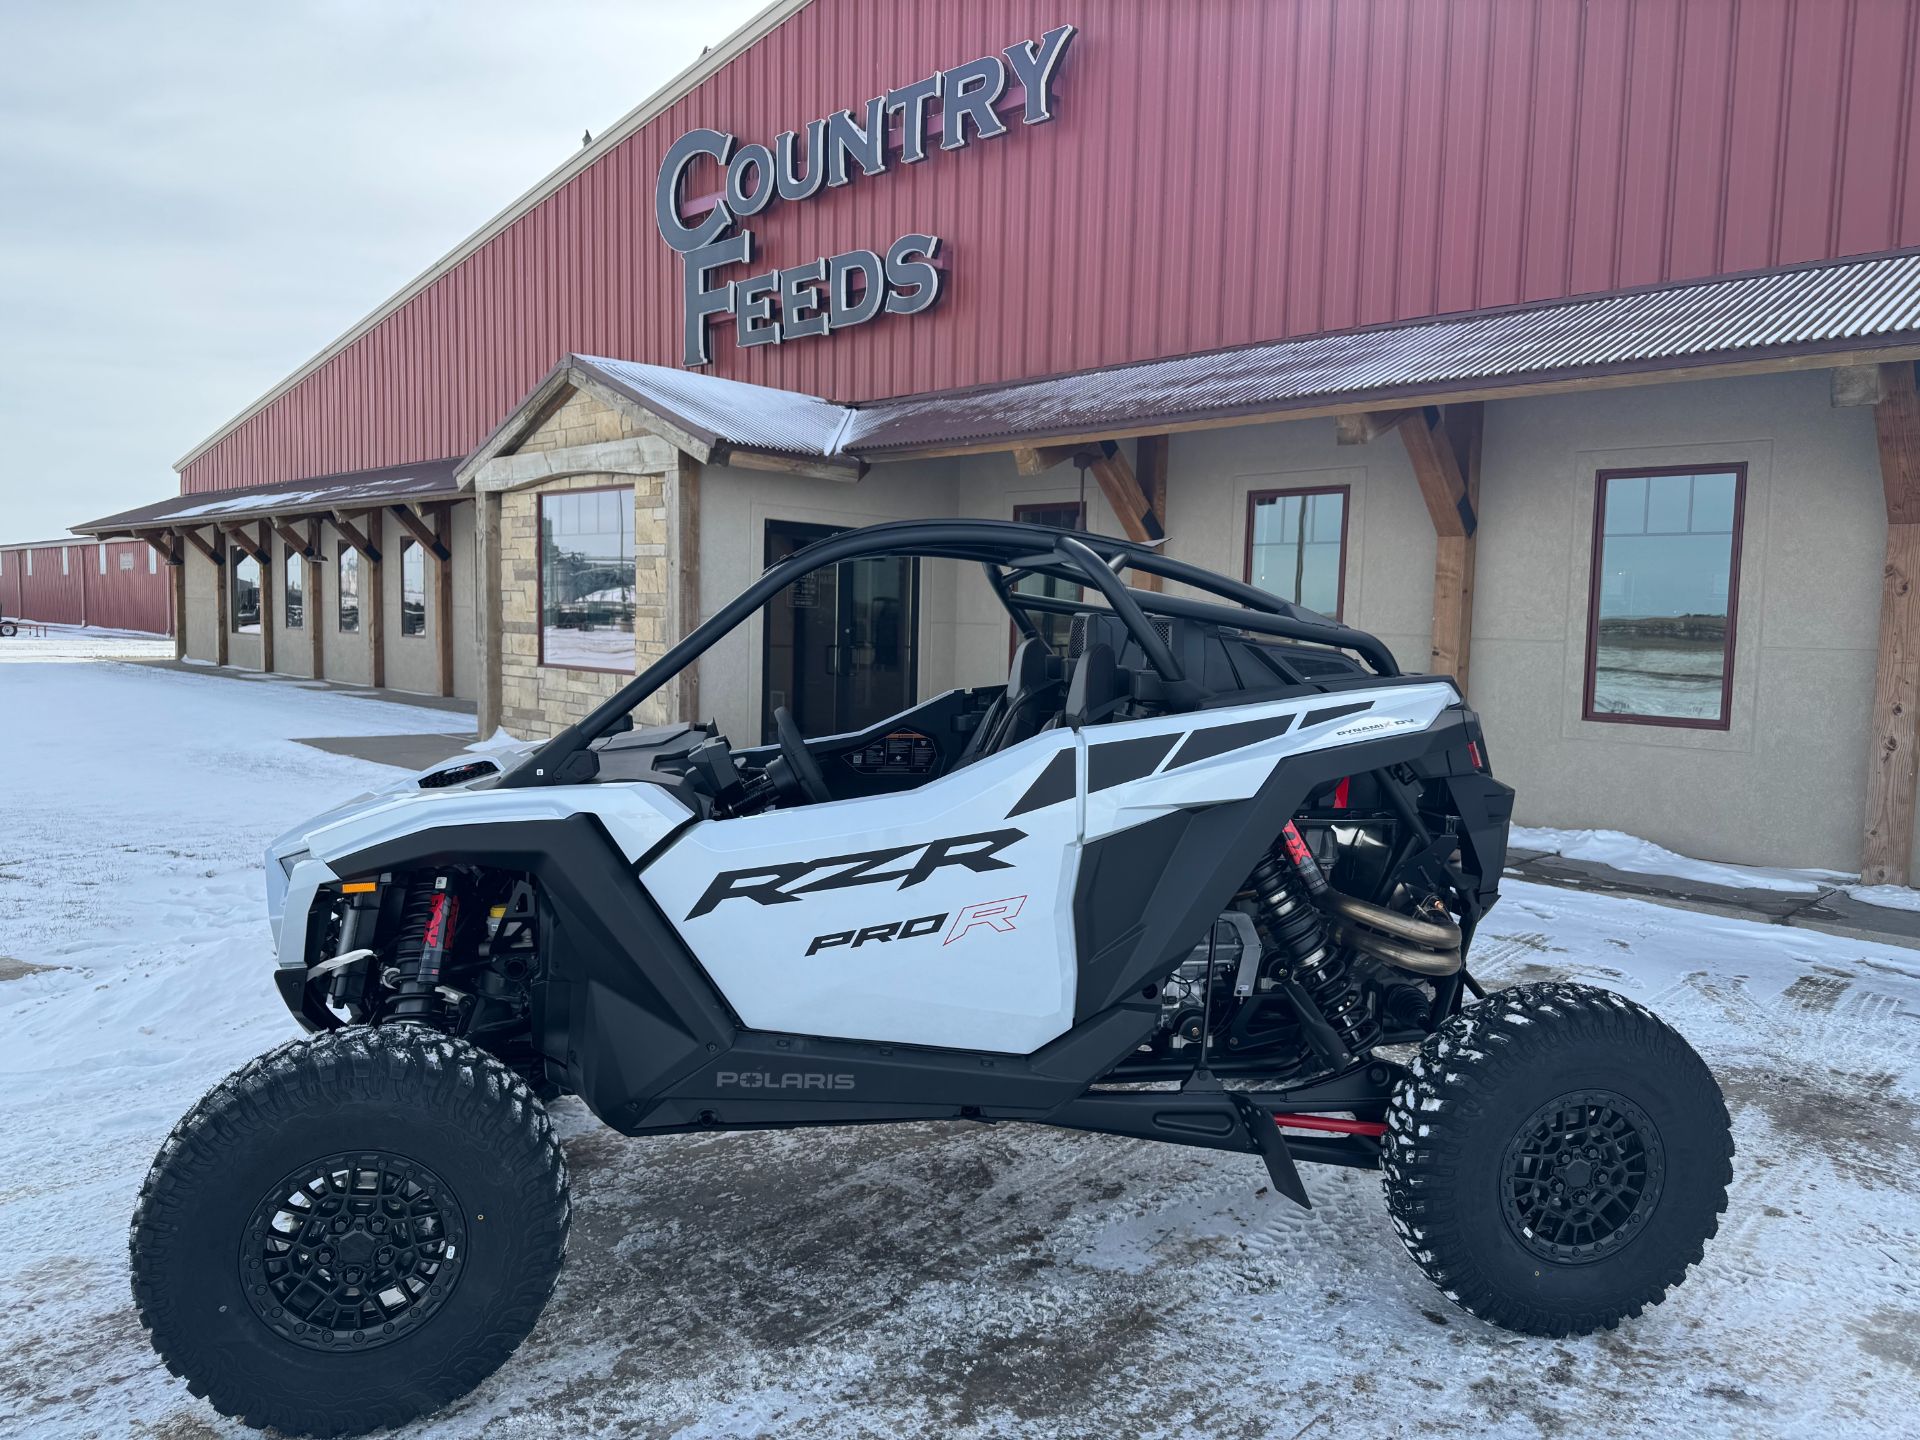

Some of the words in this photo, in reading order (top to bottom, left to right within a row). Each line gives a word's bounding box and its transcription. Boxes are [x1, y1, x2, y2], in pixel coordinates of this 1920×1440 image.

[655, 24, 1077, 253] COUNTRY
[682, 229, 942, 367] FEEDS
[1394, 718, 1415, 726] DV
[683, 827, 1029, 922] RZR
[804, 912, 949, 957] PRO
[943, 895, 1028, 947] R
[716, 1071, 856, 1090] POLARIS
